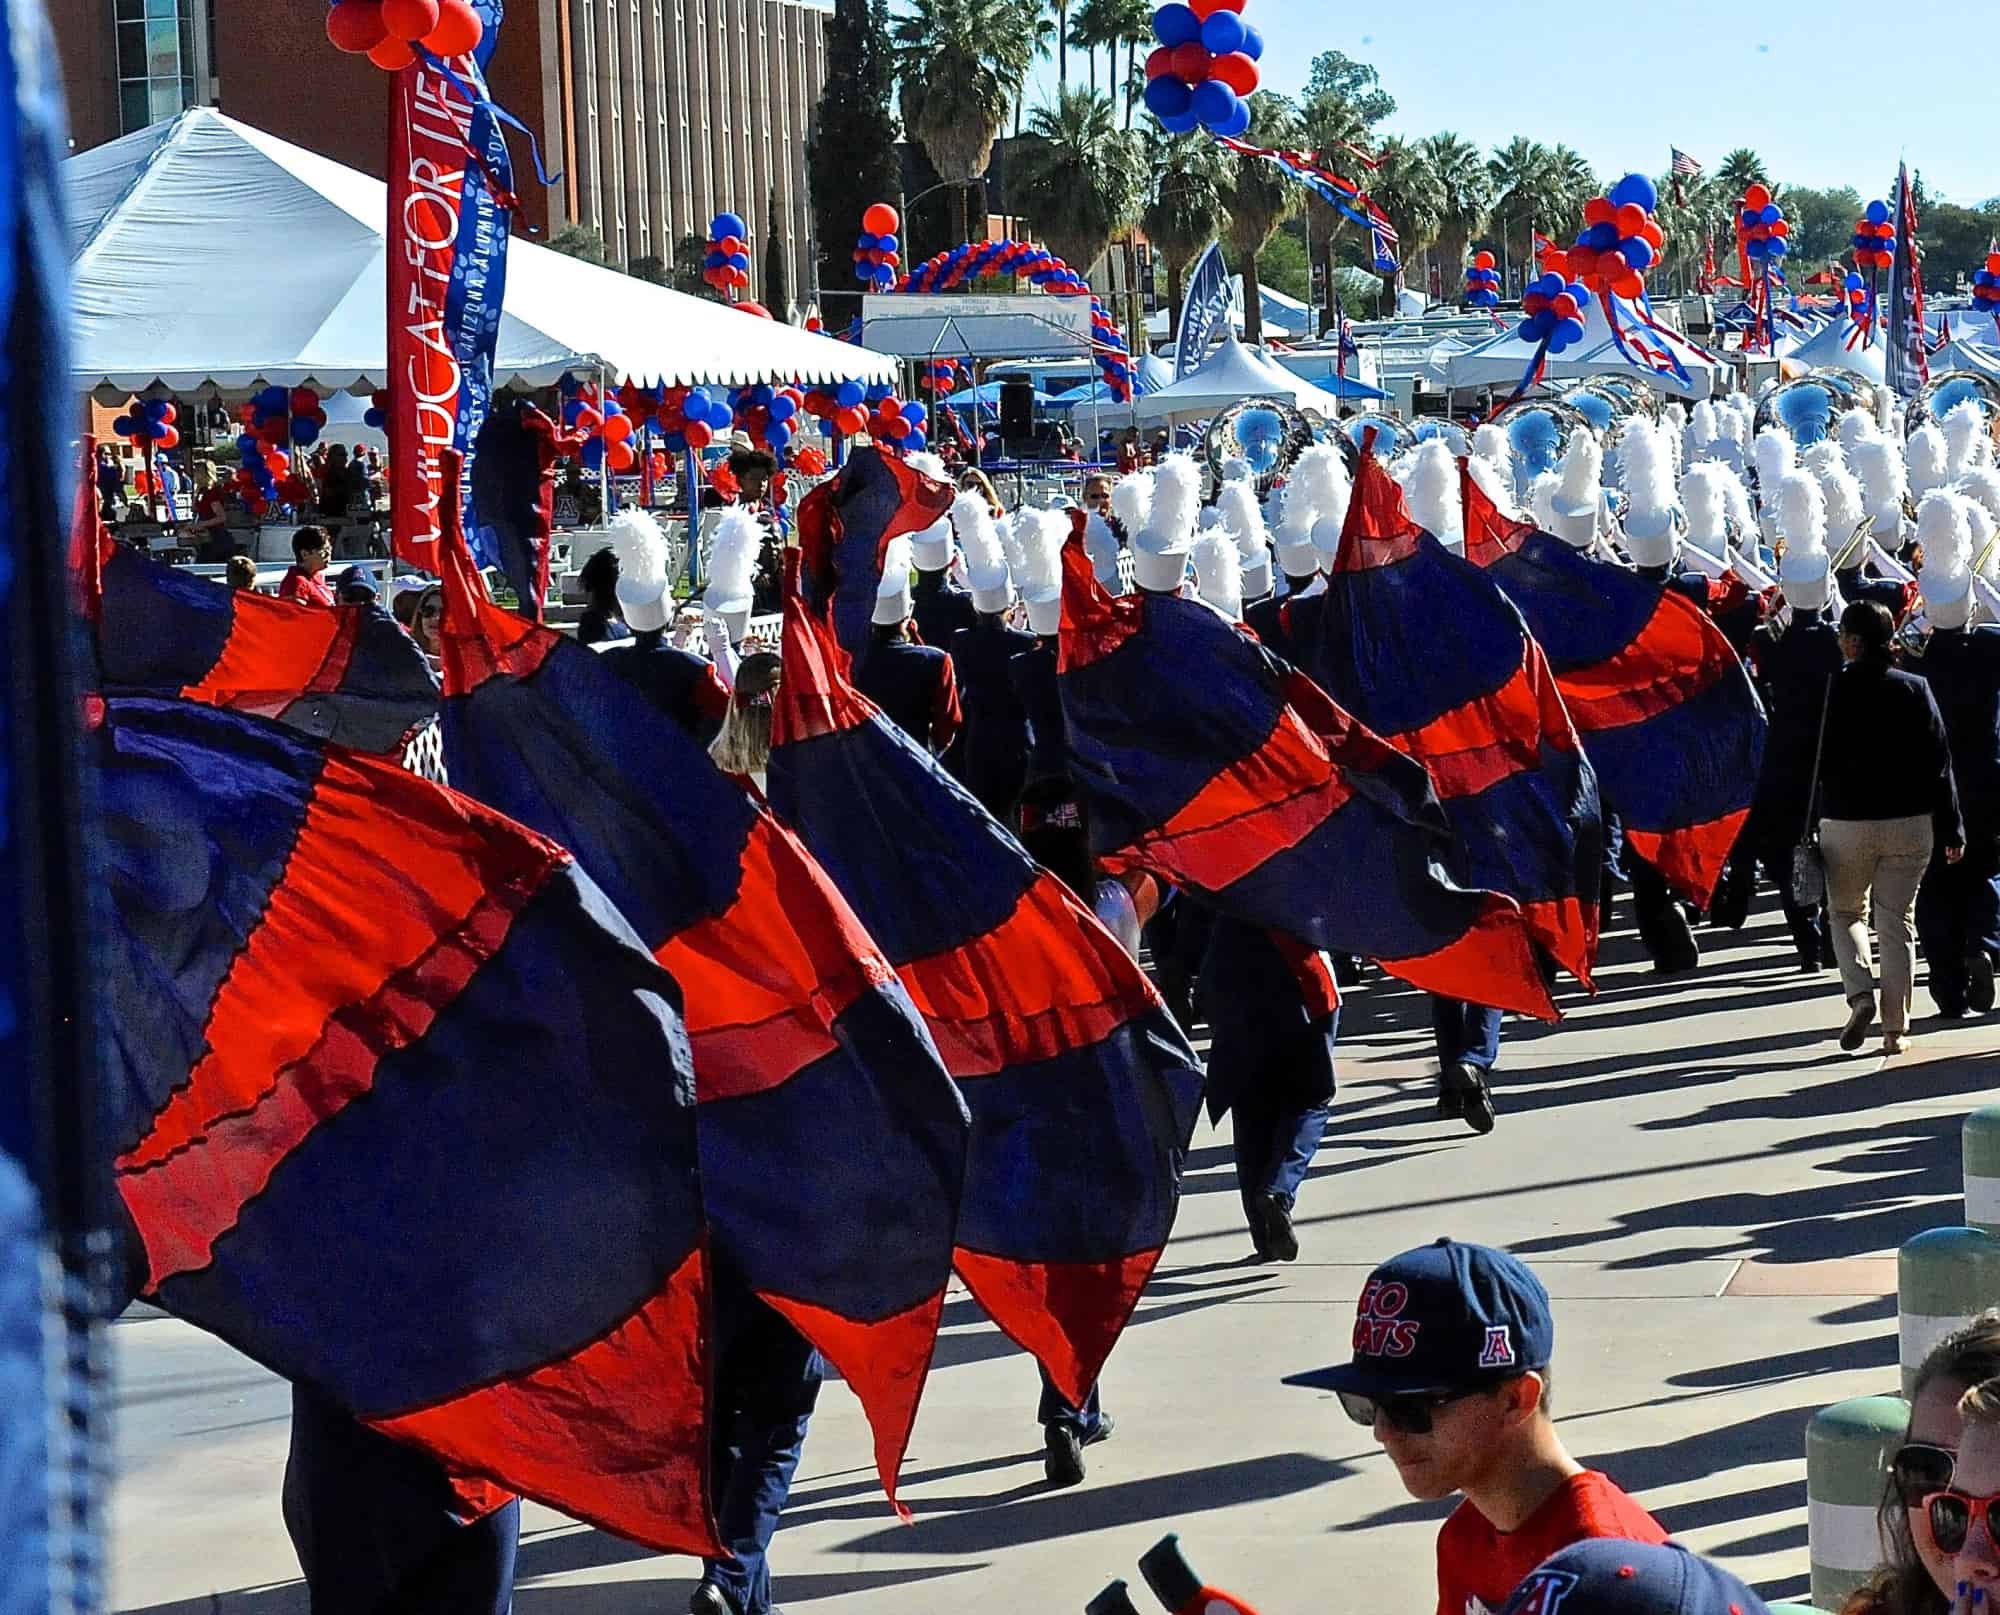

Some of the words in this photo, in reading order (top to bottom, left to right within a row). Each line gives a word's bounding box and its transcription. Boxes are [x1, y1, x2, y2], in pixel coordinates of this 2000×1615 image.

[404, 157, 465, 281] FOR
[467, 197, 495, 268] ALUMNI
[460, 277, 487, 352] ARIZONA
[1352, 1316, 1420, 1357] ATS
[1479, 1325, 1516, 1368] A
